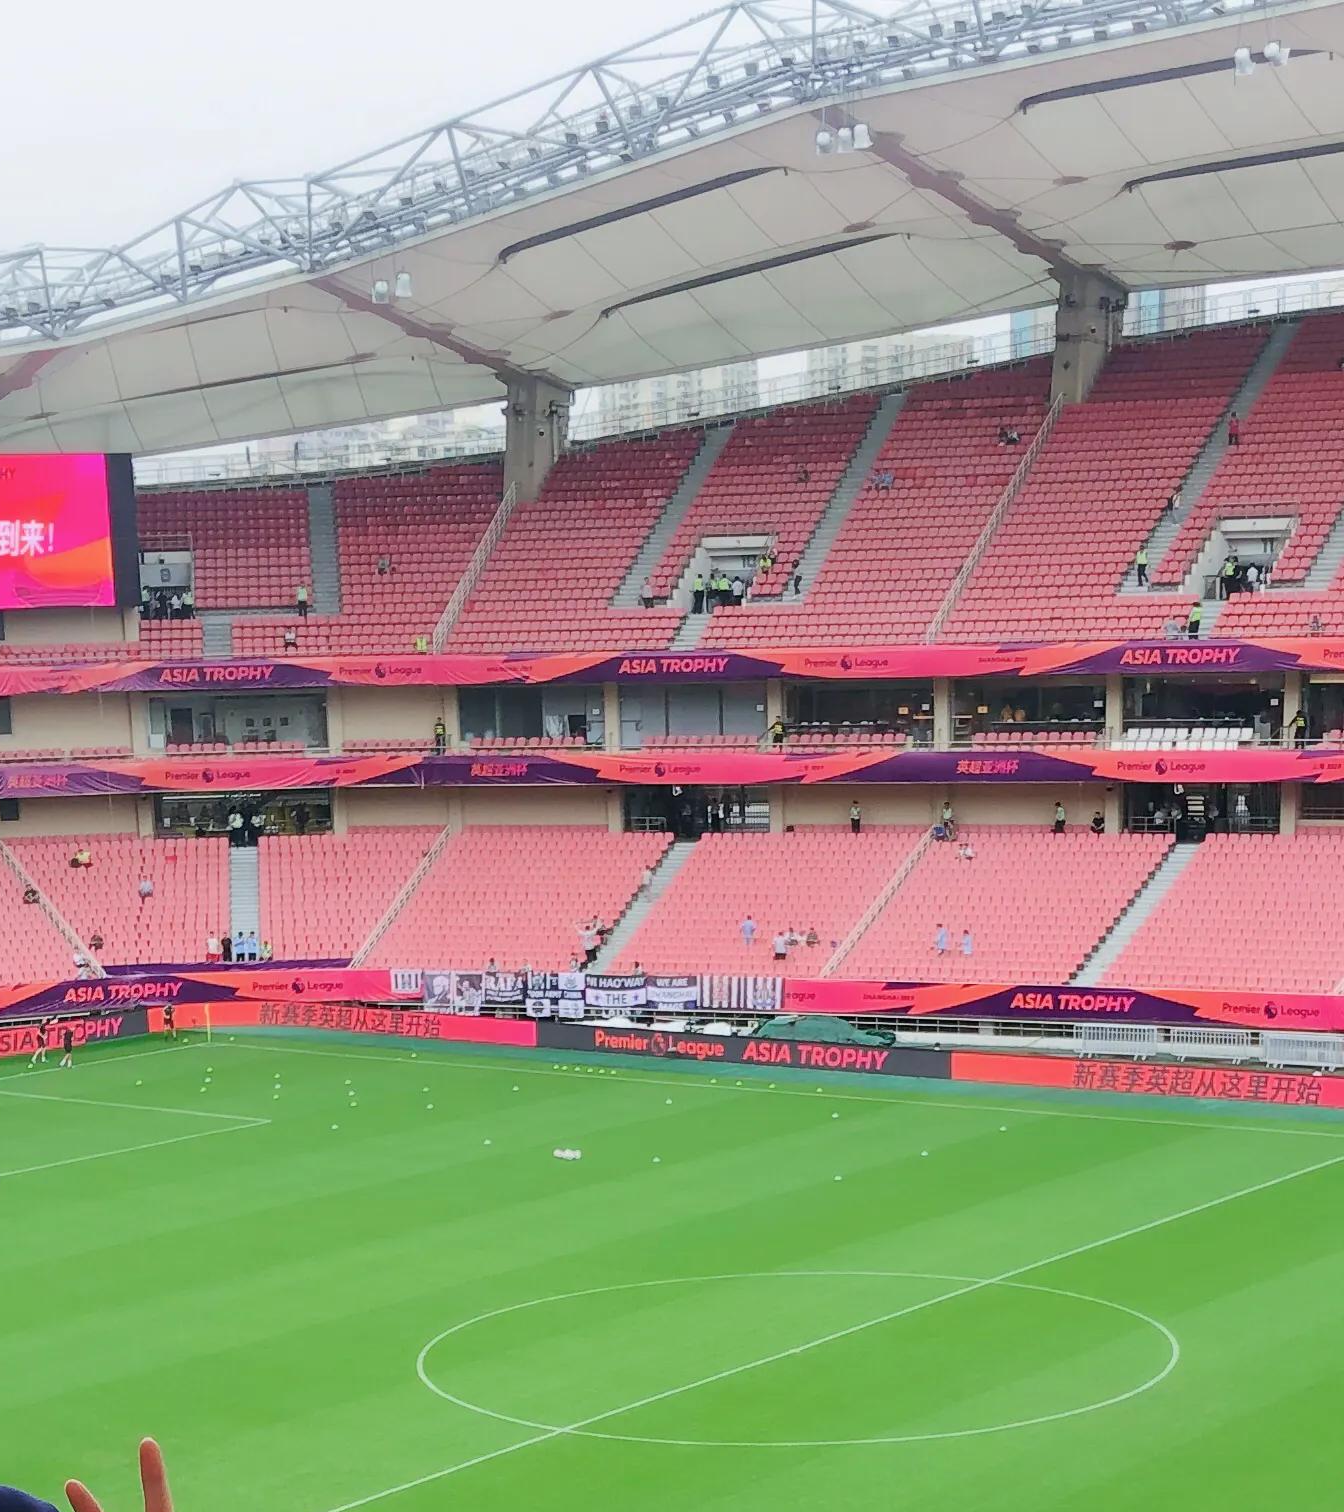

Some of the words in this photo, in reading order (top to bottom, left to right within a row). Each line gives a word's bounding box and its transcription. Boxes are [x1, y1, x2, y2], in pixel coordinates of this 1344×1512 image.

[804, 658, 838, 668] Premier
[855, 657, 888, 669] League
[1120, 649, 1162, 665] ASIA
[1167, 648, 1240, 664] TROPHY
[339, 666, 371, 676] Premier
[388, 665, 422, 676] League
[618, 658, 656, 674] ASIA
[660, 657, 728, 673] TROPHY
[160, 667, 200, 682] ASIA
[203, 666, 275, 682] TROPHY
[619, 764, 651, 774] Premier
[1117, 761, 1152, 772] Premier
[1170, 761, 1206, 773] League
[164, 771, 200, 782] Premier
[216, 771, 251, 782] League
[252, 981, 289, 993] Premier
[306, 980, 344, 993] League
[672, 978, 688, 987] ARE
[64, 986, 104, 1003] ASIA
[108, 981, 184, 1000] TROPHY
[785, 992, 816, 1002] eague
[605, 993, 627, 1005] THE
[1011, 993, 1055, 1010] ASIA
[1058, 994, 1136, 1012] TROPHY
[1221, 1004, 1260, 1016] Premier
[1280, 1005, 1320, 1018] League
[594, 1028, 649, 1052] Premier
[667, 1034, 725, 1059] League
[742, 1043, 793, 1065] ASIA
[797, 1044, 890, 1071] TROPHY
[1072, 1062, 1323, 1106] 新赛季英超从这里开始
